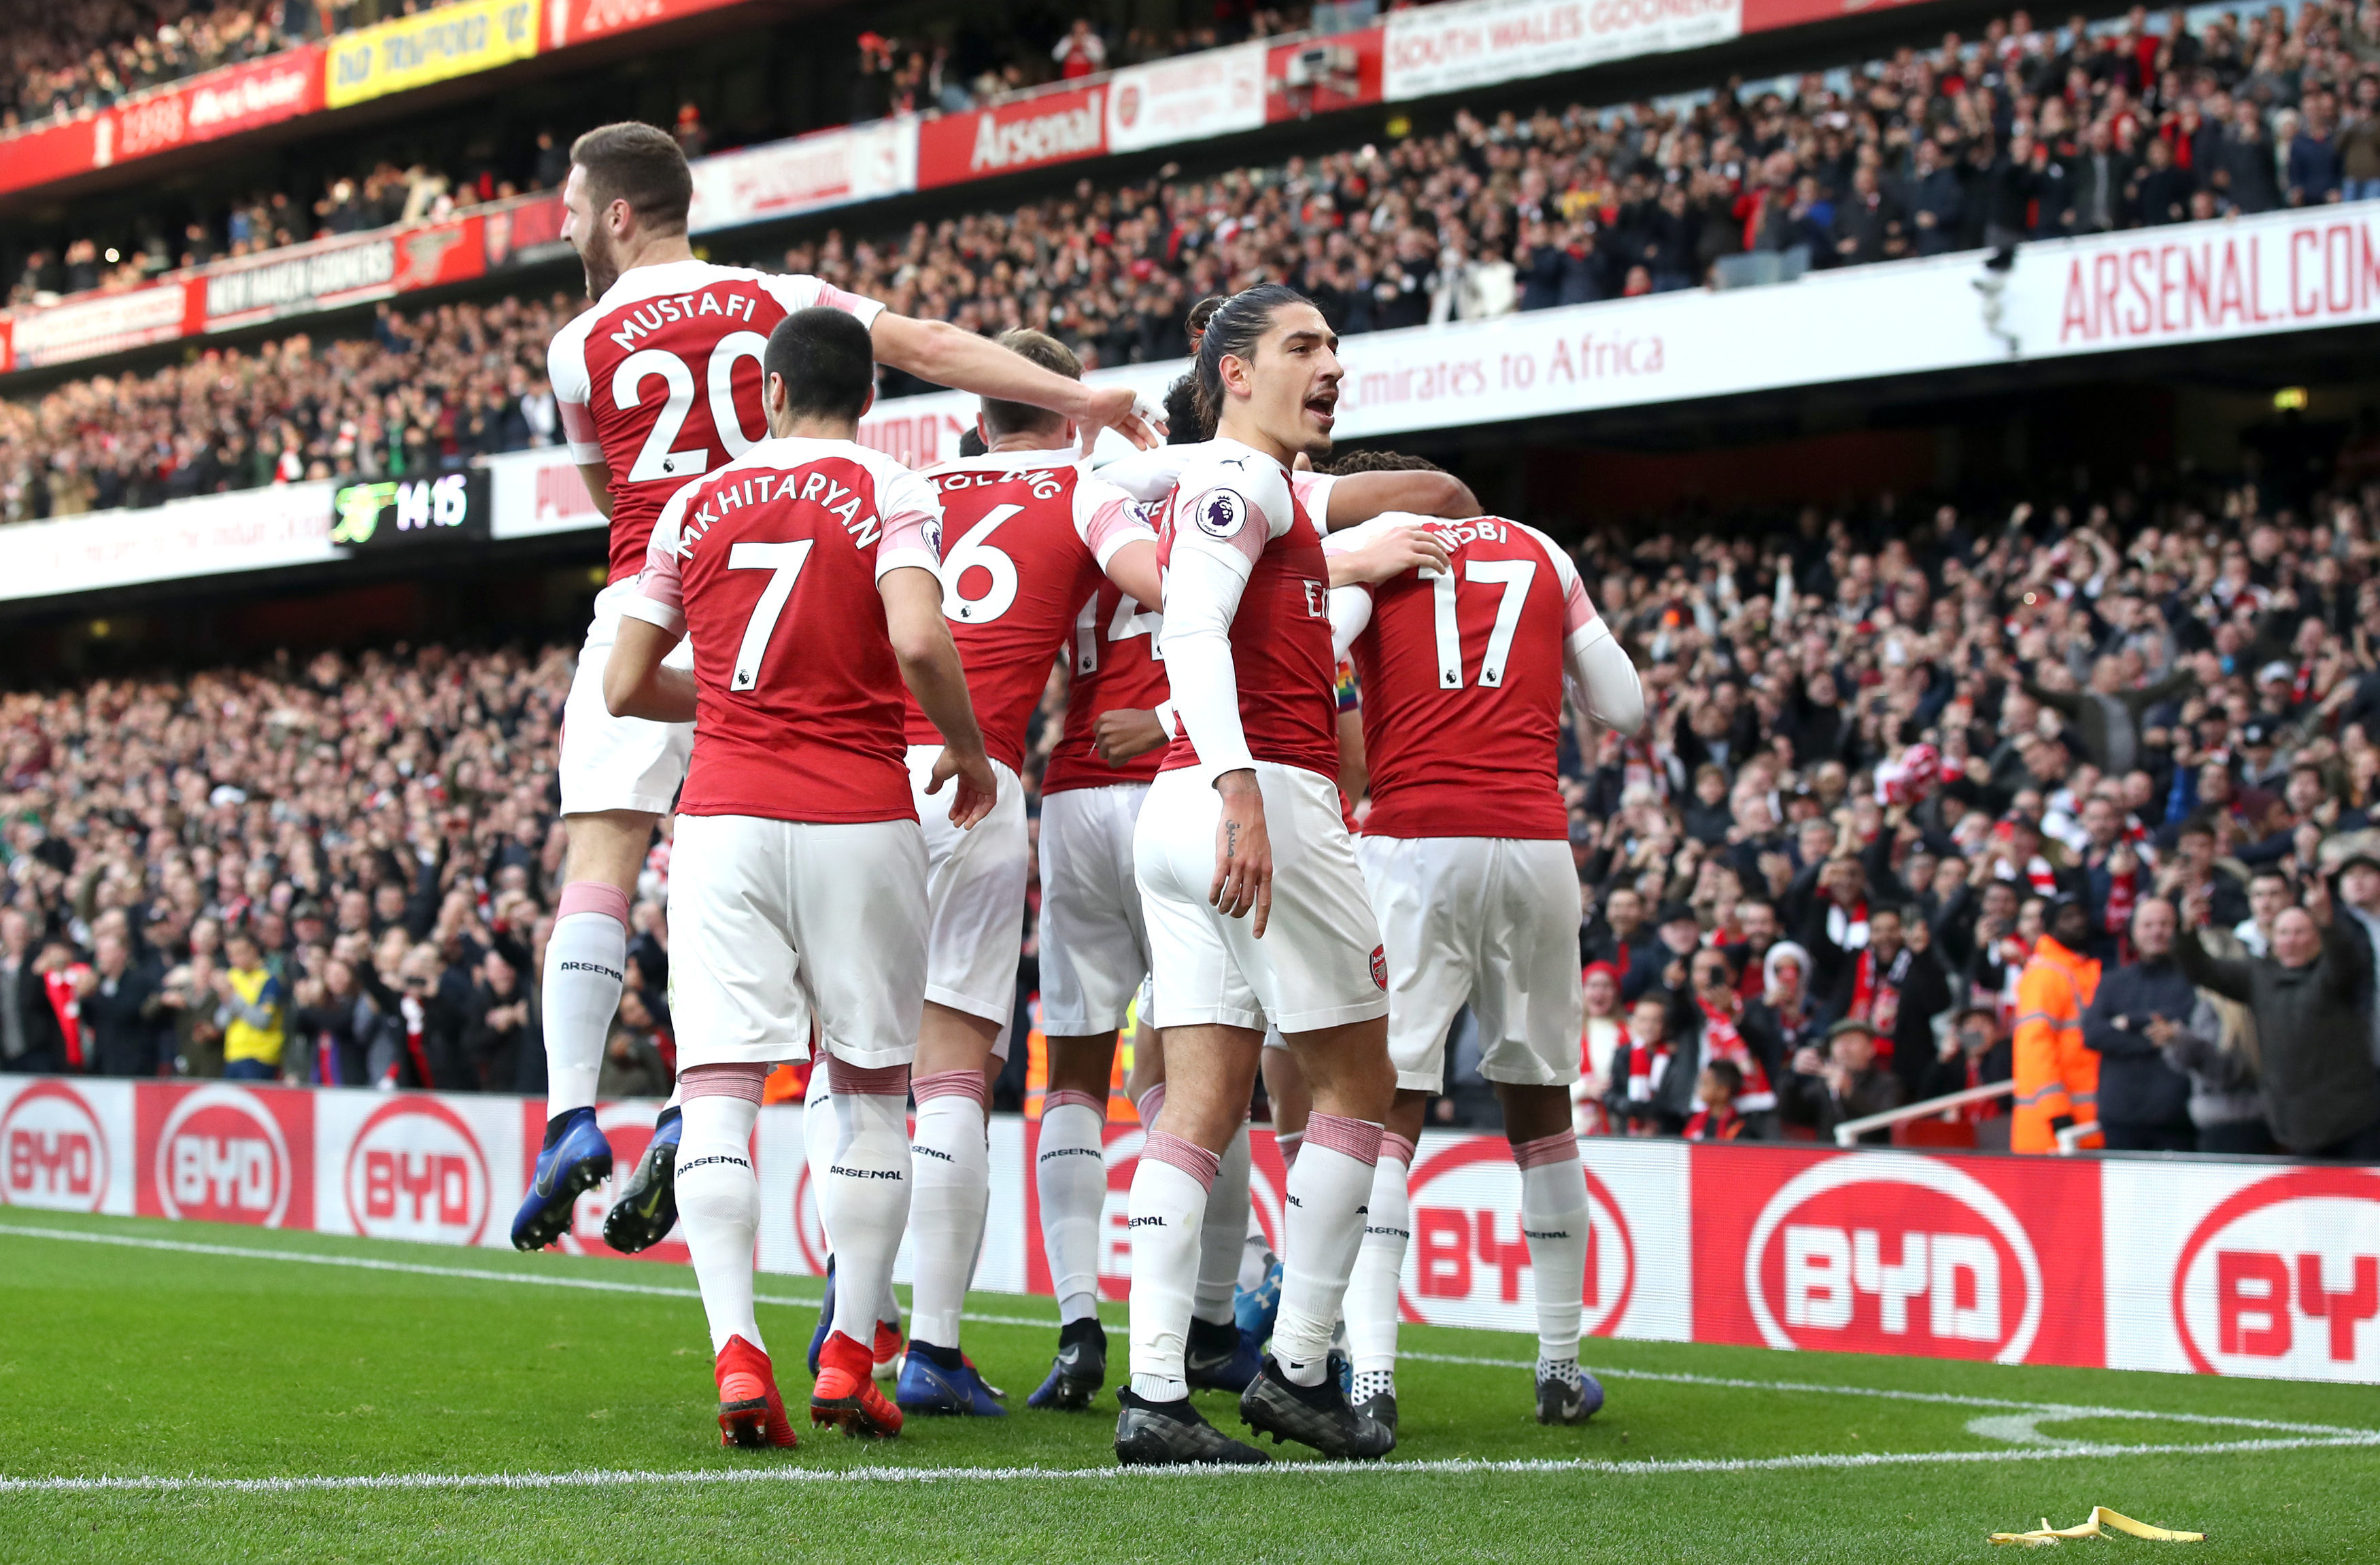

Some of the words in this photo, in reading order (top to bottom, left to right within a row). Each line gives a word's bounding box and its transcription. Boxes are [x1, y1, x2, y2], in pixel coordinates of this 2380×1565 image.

[1391, 27, 1482, 71] SOUTH
[1487, 3, 1582, 50] WALES
[970, 90, 1102, 173] Arsenal
[611, 292, 756, 353] MUSTAFI
[612, 330, 770, 483] 20
[1338, 359, 1487, 412] Emirates
[1500, 352, 1536, 390] to
[1546, 331, 1665, 384] Africa
[677, 471, 882, 560] MKHITARYAN
[941, 503, 1026, 624] 6
[727, 538, 815, 692] 7
[1076, 589, 1165, 676] 14
[1418, 559, 1537, 689] 17
[10, 1128, 92, 1194] BYD
[175, 1134, 272, 1213] BYD
[364, 1150, 470, 1225] BYD
[677, 1156, 750, 1178] ARSENAL
[830, 1165, 904, 1181] ARSENAL
[1040, 1148, 1103, 1163] ARSENAL
[1416, 1206, 1599, 1307] BY
[1784, 1224, 2001, 1343] BYD
